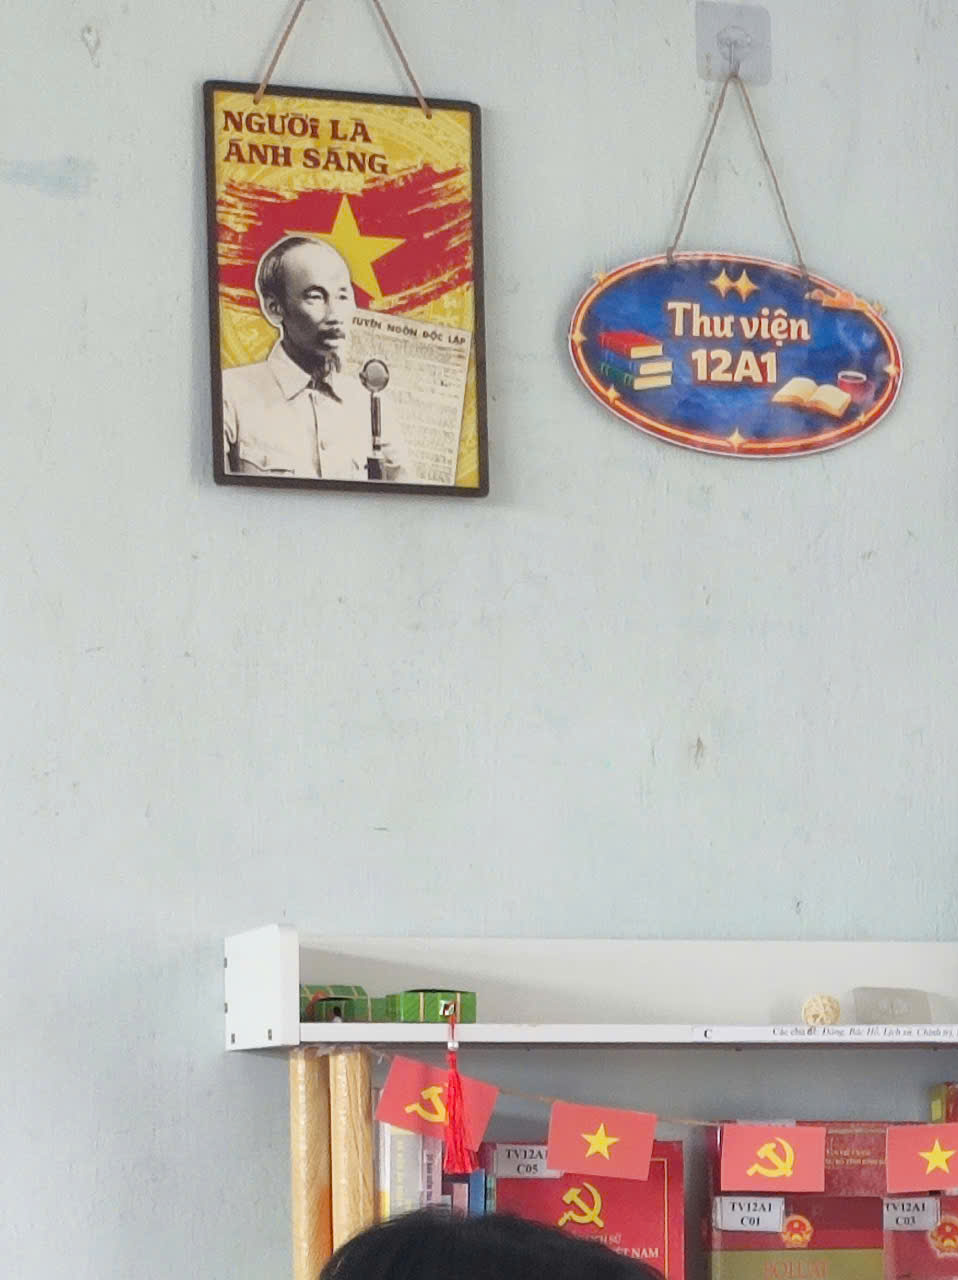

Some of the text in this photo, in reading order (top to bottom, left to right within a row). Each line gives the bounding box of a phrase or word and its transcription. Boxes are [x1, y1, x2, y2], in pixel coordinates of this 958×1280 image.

[223, 110, 320, 140] NGƯỜI
[667, 301, 812, 347] Thư viện
[691, 348, 778, 385] 12A1
[704, 1028, 712, 1039] C
[505, 1148, 546, 1160] TV12A
[516, 1163, 539, 1174] C05
[730, 1201, 772, 1212] TV12A1
[740, 1215, 761, 1227] C01
[895, 1216, 917, 1226] C03
[631, 1247, 659, 1259] NAM
